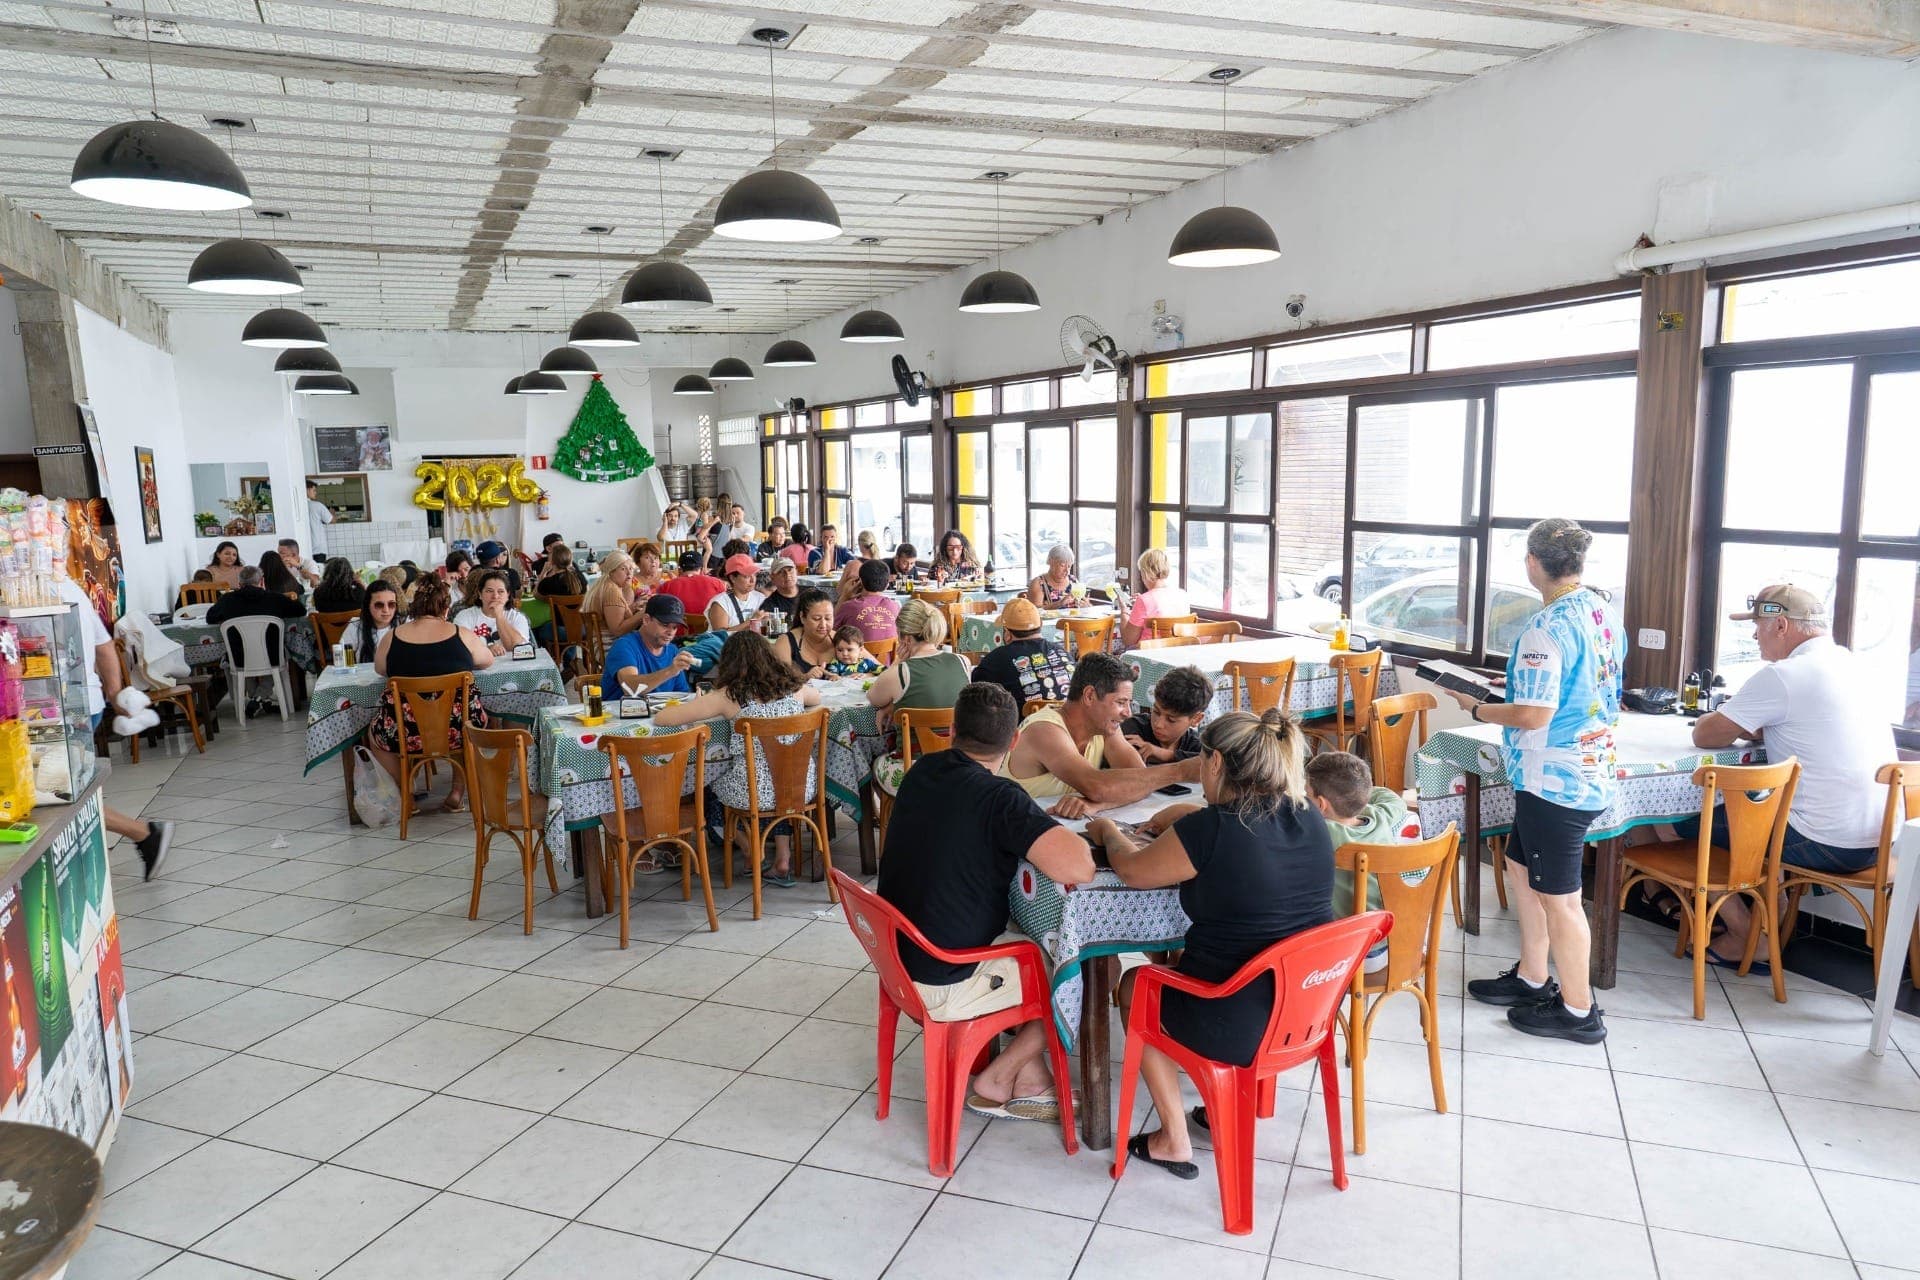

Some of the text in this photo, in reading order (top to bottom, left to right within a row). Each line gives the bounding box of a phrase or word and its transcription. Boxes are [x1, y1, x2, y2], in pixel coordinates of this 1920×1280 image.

[414, 462, 538, 510] 2026
[1522, 652, 1548, 660] IMPACTO
[77, 792, 99, 834] SPATEN
[52, 819, 78, 866] SPATEN
[1302, 956, 1352, 989] Coca-Cola
